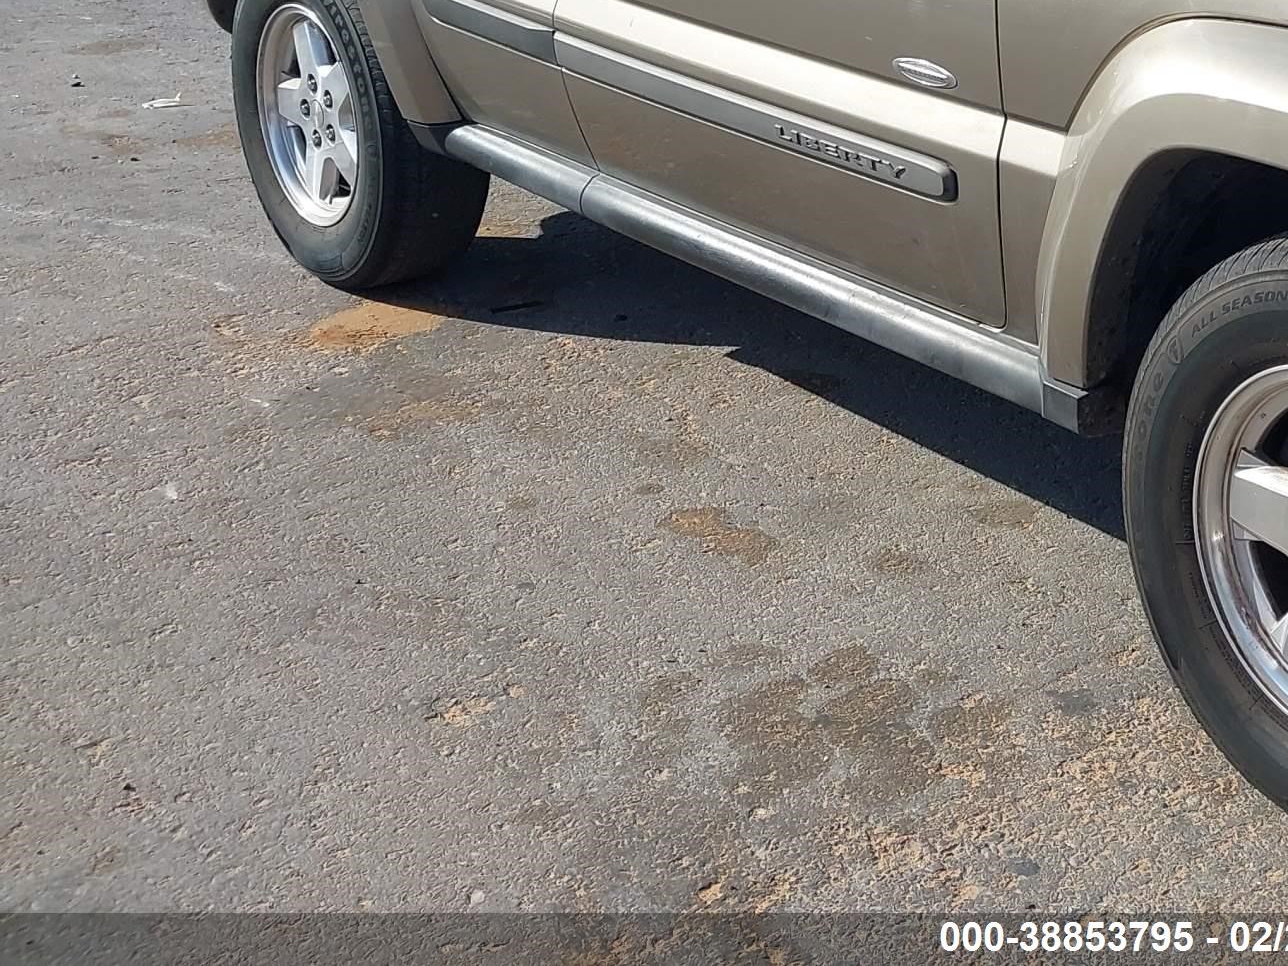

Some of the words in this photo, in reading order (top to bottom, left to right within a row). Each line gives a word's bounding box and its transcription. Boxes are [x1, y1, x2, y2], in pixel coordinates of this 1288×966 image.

[774, 123, 907, 180] LIBERTY
[1191, 312, 1218, 338] ALL
[1220, 290, 1288, 315] SEASON
